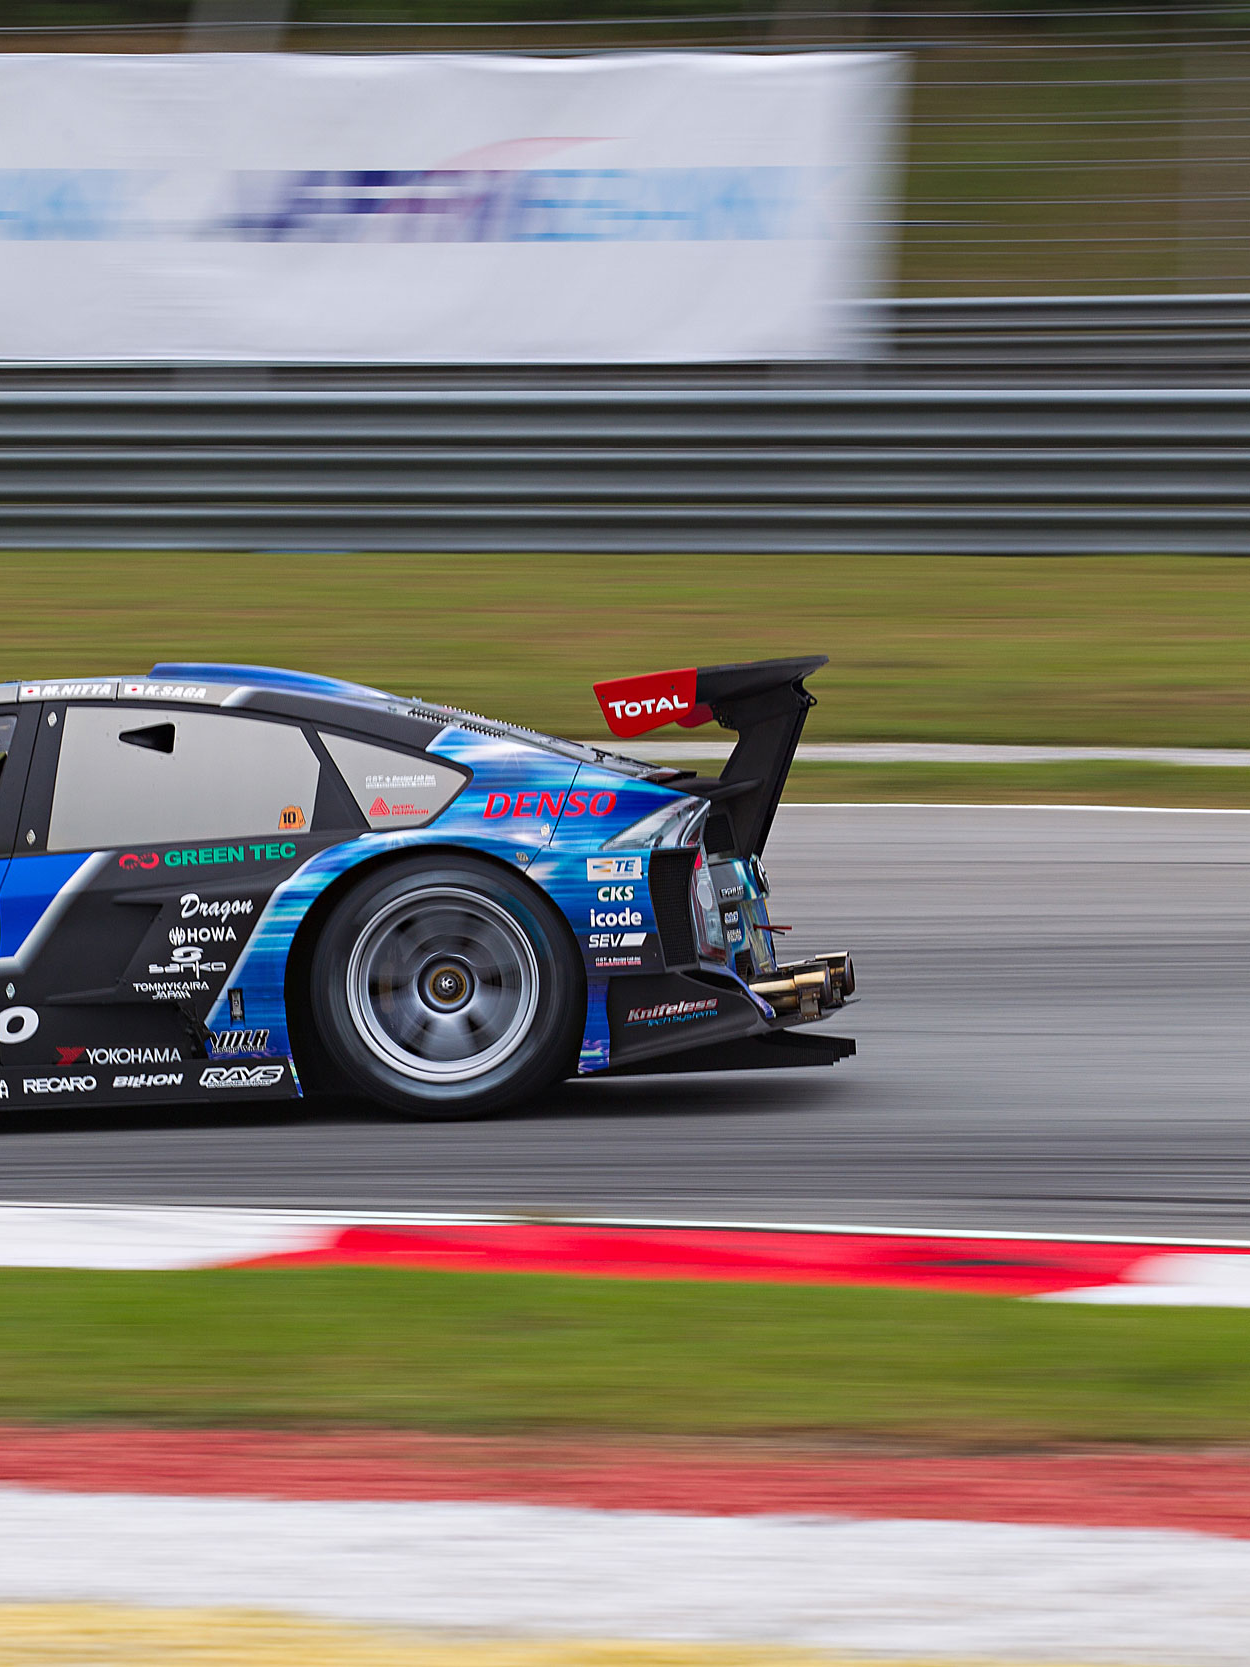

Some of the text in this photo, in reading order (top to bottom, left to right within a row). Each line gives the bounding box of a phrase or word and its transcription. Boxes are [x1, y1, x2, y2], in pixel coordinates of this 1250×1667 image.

[608, 694, 688, 718] TOTAL
[483, 791, 617, 819] DENSO
[283, 812, 296, 824] 10
[164, 842, 296, 867] GREEN TEC
[598, 886, 634, 902] CKS
[180, 892, 253, 923] Dragon
[590, 907, 642, 927] icode
[187, 926, 237, 943] HOWA
[589, 933, 622, 948] SEV
[133, 981, 210, 992] TOMMYKAIRA
[152, 990, 191, 1000] JAPAN
[627, 999, 717, 1022] Knifeless
[85, 1047, 182, 1065] YOKOHAMA
[23, 1075, 97, 1094] RECARO
[113, 1073, 183, 1088] BILLION
[199, 1065, 284, 1087] RAYS
